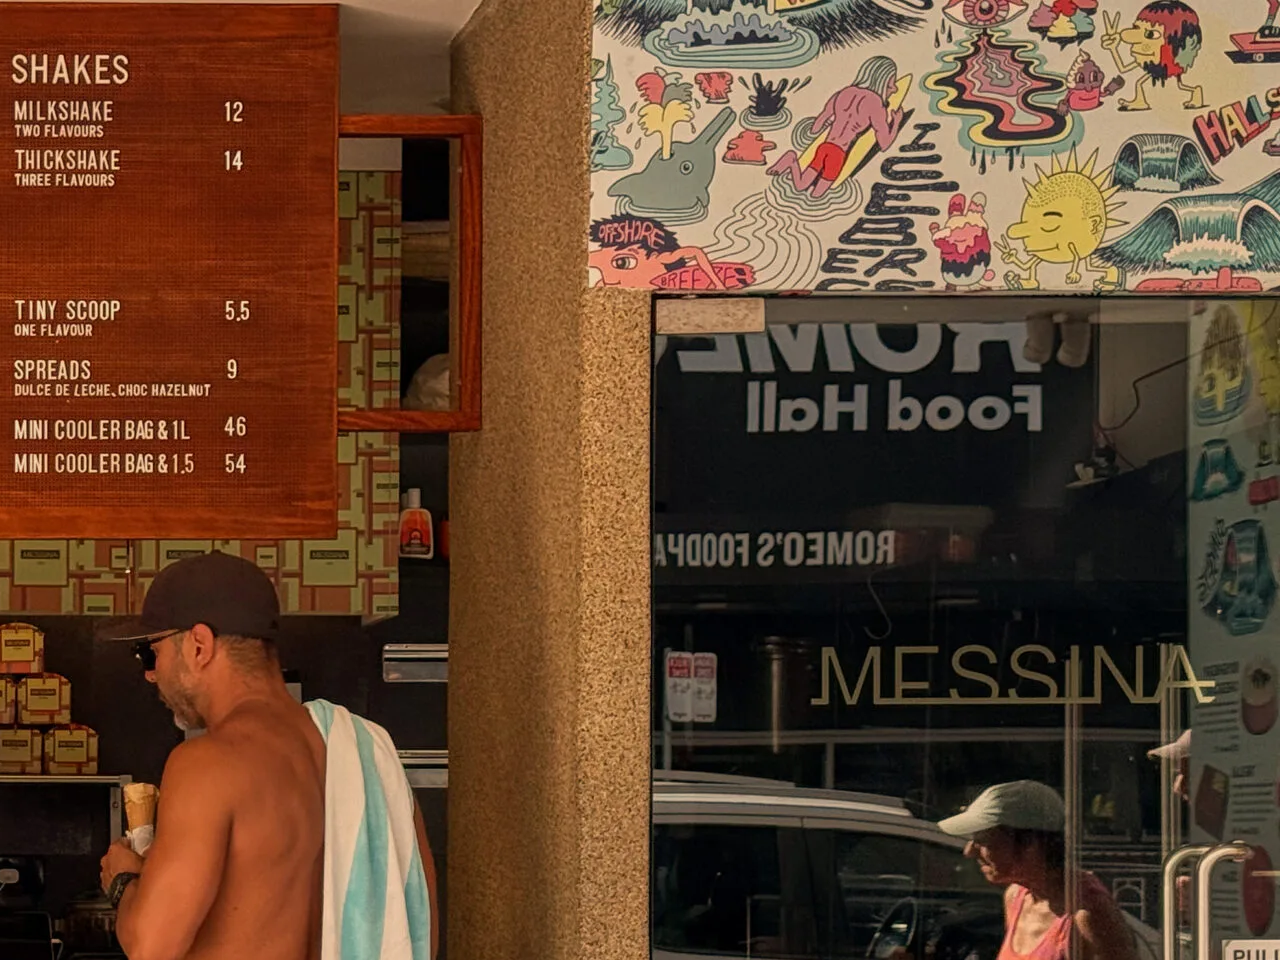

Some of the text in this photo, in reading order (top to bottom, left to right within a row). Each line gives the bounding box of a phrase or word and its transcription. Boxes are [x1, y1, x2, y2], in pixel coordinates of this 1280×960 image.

[11, 53, 129, 85] SHAKES
[14, 100, 113, 122] MILKSHAKE
[224, 101, 243, 122] 12
[14, 124, 104, 138] TWO FLAVOURS
[14, 149, 121, 171] THICKSHAKE
[224, 150, 243, 171] 14
[14, 173, 115, 187] THREE FLAVOURS
[599, 220, 665, 249] OFFSHORE
[14, 299, 121, 321] TINY SCOOP
[225, 300, 250, 322] 5.5
[14, 323, 93, 337] ONE FLAVOUR
[14, 359, 91, 381] SPREADS
[227, 358, 237, 379] 9
[14, 383, 52, 397] DULCE
[55, 383, 70, 397] DE
[118, 384, 148, 397] CHOC
[151, 383, 211, 397] HAZELNUT
[14, 419, 191, 440] MINI COOLER BAG & 1L
[224, 416, 246, 437] 46
[14, 453, 48, 474] MINI
[55, 453, 121, 474] COOLER
[125, 453, 154, 474] BAG
[157, 453, 169, 474] &
[225, 453, 247, 474] 54
[811, 644, 1217, 705] MESSINA
